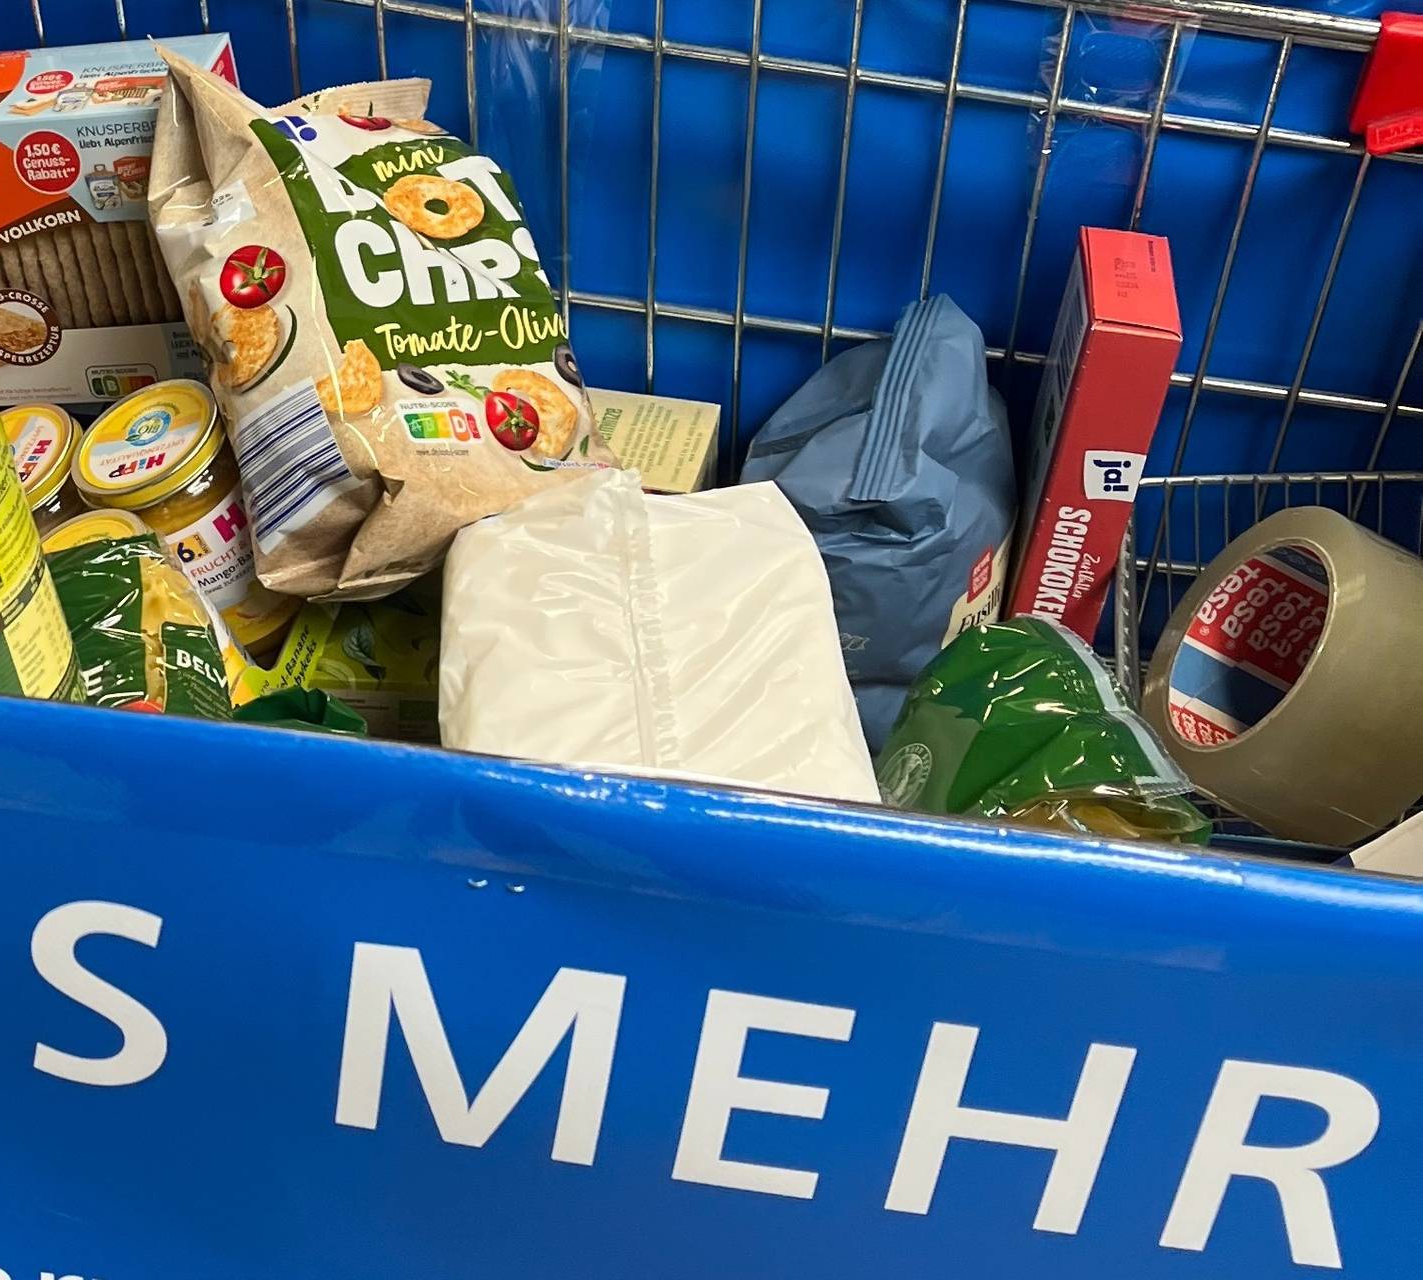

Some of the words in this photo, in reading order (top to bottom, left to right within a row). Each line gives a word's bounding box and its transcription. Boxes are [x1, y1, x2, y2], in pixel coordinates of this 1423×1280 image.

[22, 156, 71, 170] Genuss-
[24, 143, 51, 158] 1,50
[51, 143, 62, 156] €
[372, 146, 445, 182] mini
[400, 400, 458, 411] NUTRI-SCORE
[454, 416, 467, 433] D
[1093, 459, 1131, 492] ja!
[190, 547, 237, 577] FRUCHT
[1196, 563, 1262, 625] tesa
[1220, 577, 1288, 640] tesa
[1247, 592, 1314, 652] tesa
[335, 941, 1380, 1269] MEHR
